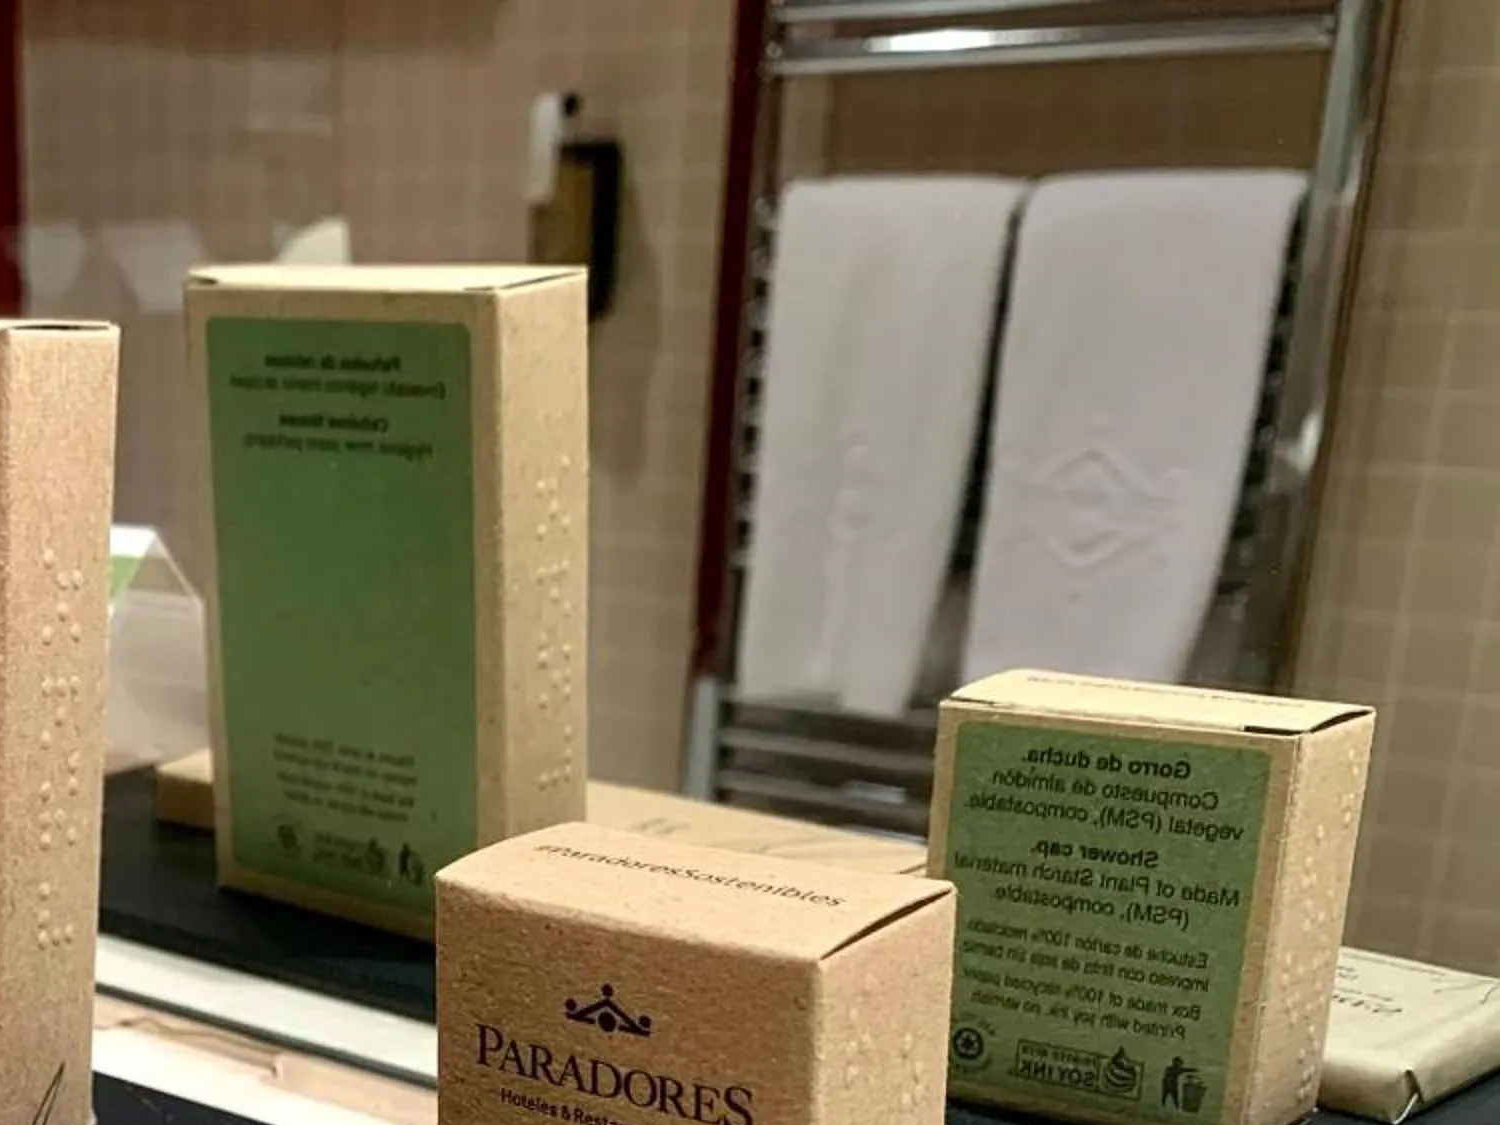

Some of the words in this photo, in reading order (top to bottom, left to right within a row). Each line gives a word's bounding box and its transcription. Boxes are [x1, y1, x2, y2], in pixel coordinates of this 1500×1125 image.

[535, 844, 845, 907] #ParadoresSostenibles
[501, 1088, 558, 1118] Hoteles
[561, 1104, 571, 1121] &
